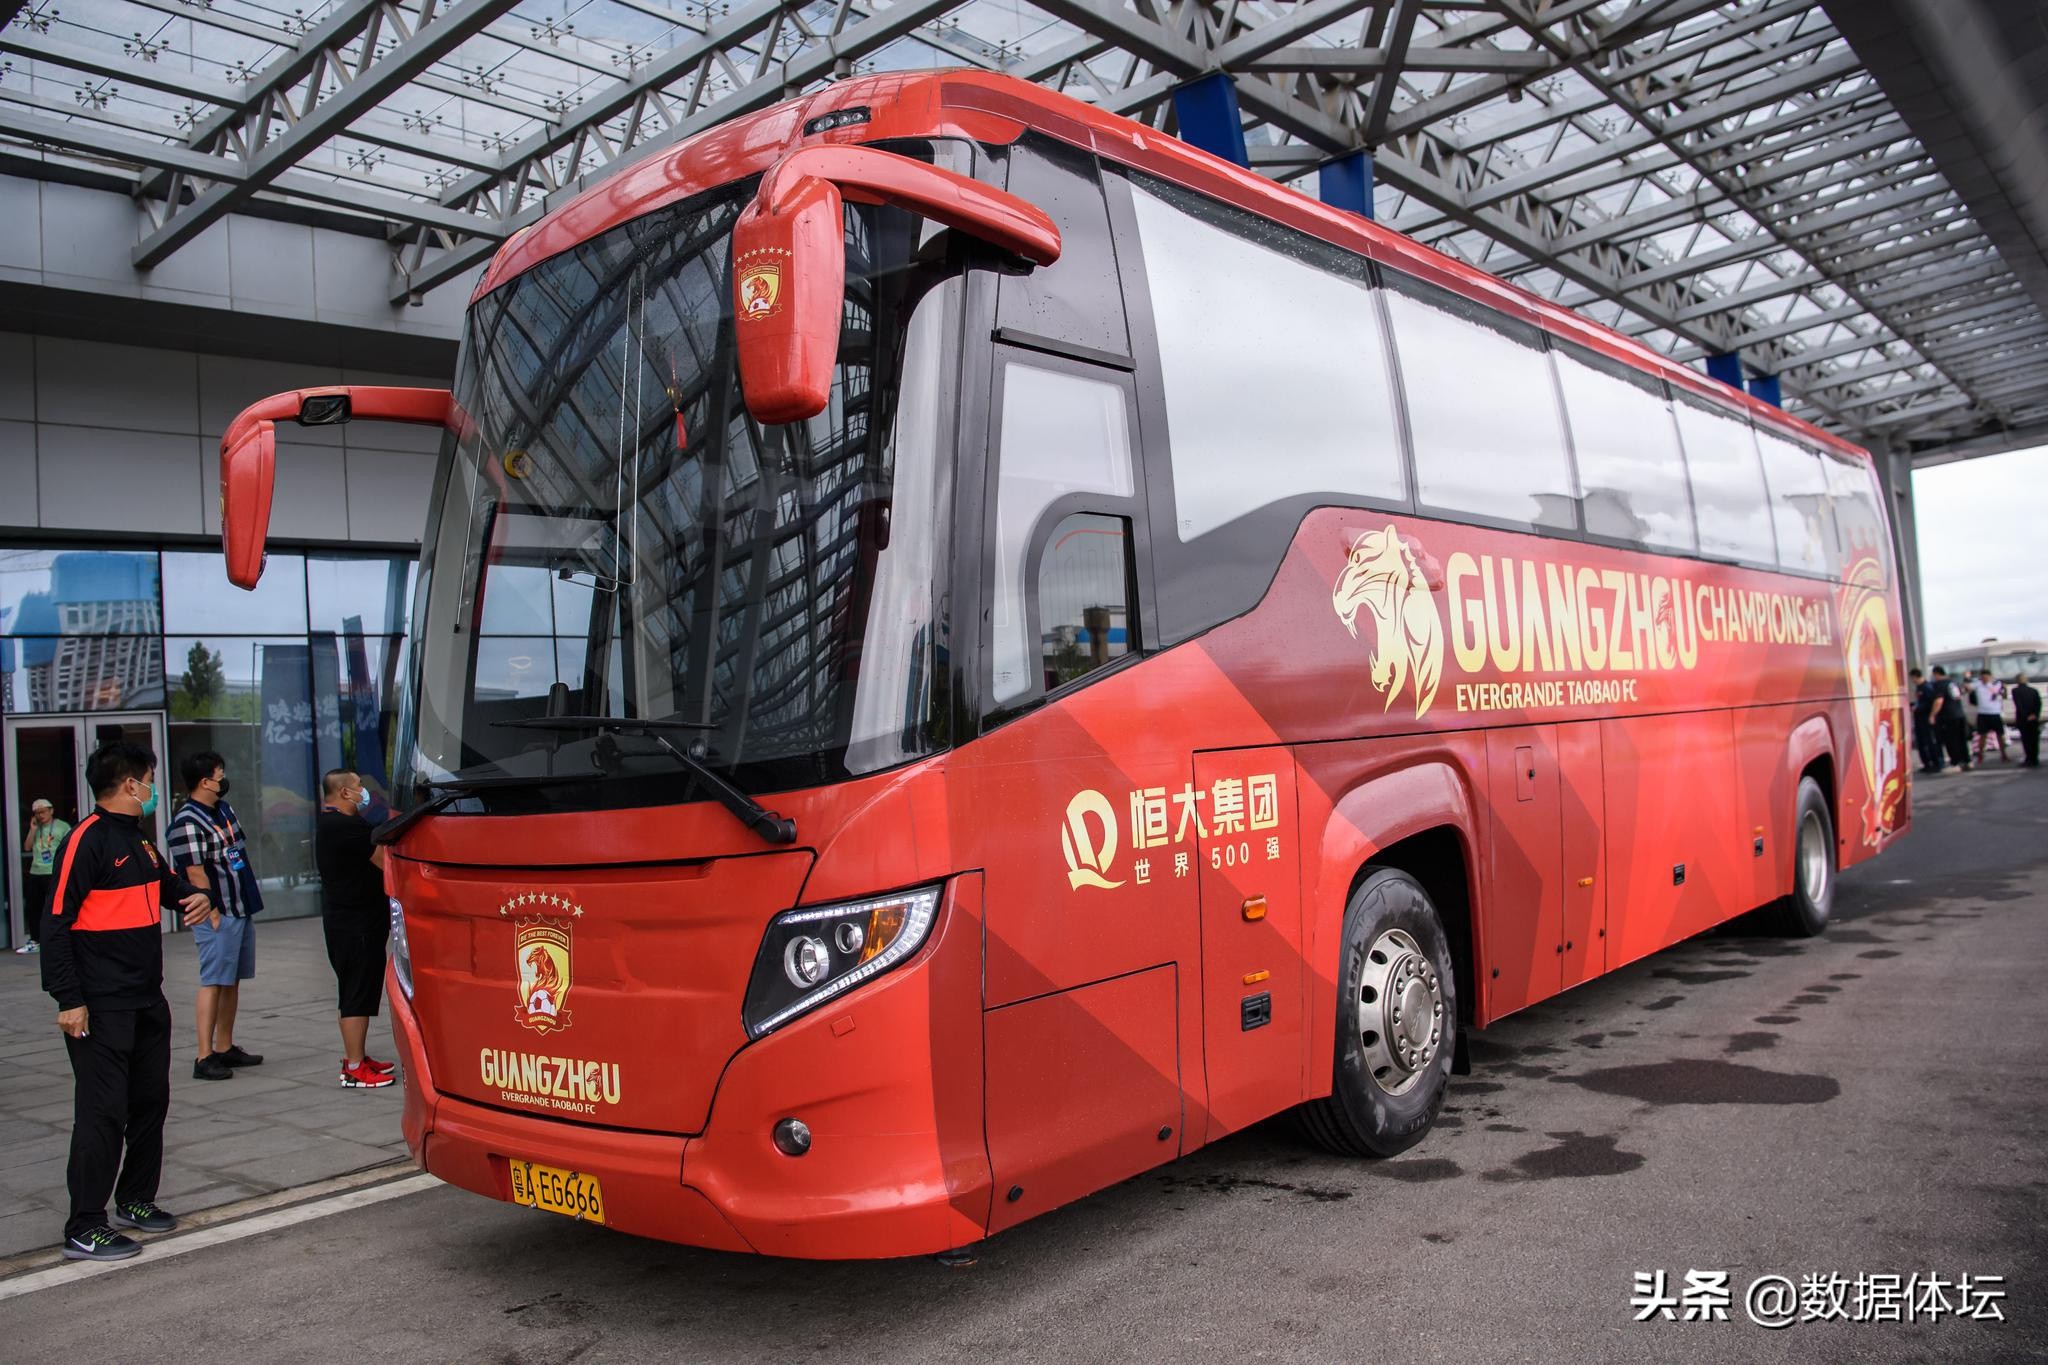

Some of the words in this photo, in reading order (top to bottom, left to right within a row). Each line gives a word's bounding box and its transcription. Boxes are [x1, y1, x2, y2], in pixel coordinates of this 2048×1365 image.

[1446, 551, 1698, 673] GUANGZHOU
[1699, 584, 1806, 645] CHAMPIONS
[1456, 681, 1564, 712] EVERGRANDE
[1567, 679, 1620, 705] TAOBAO
[1622, 679, 1638, 702] FC
[1130, 773, 1279, 850] 恒大集团
[480, 1047, 621, 1105] GUANGZHOU
[501, 1090, 550, 1108] EVERGRANDE
[550, 1098, 584, 1114] TAOBAO
[585, 1103, 596, 1115] FC
